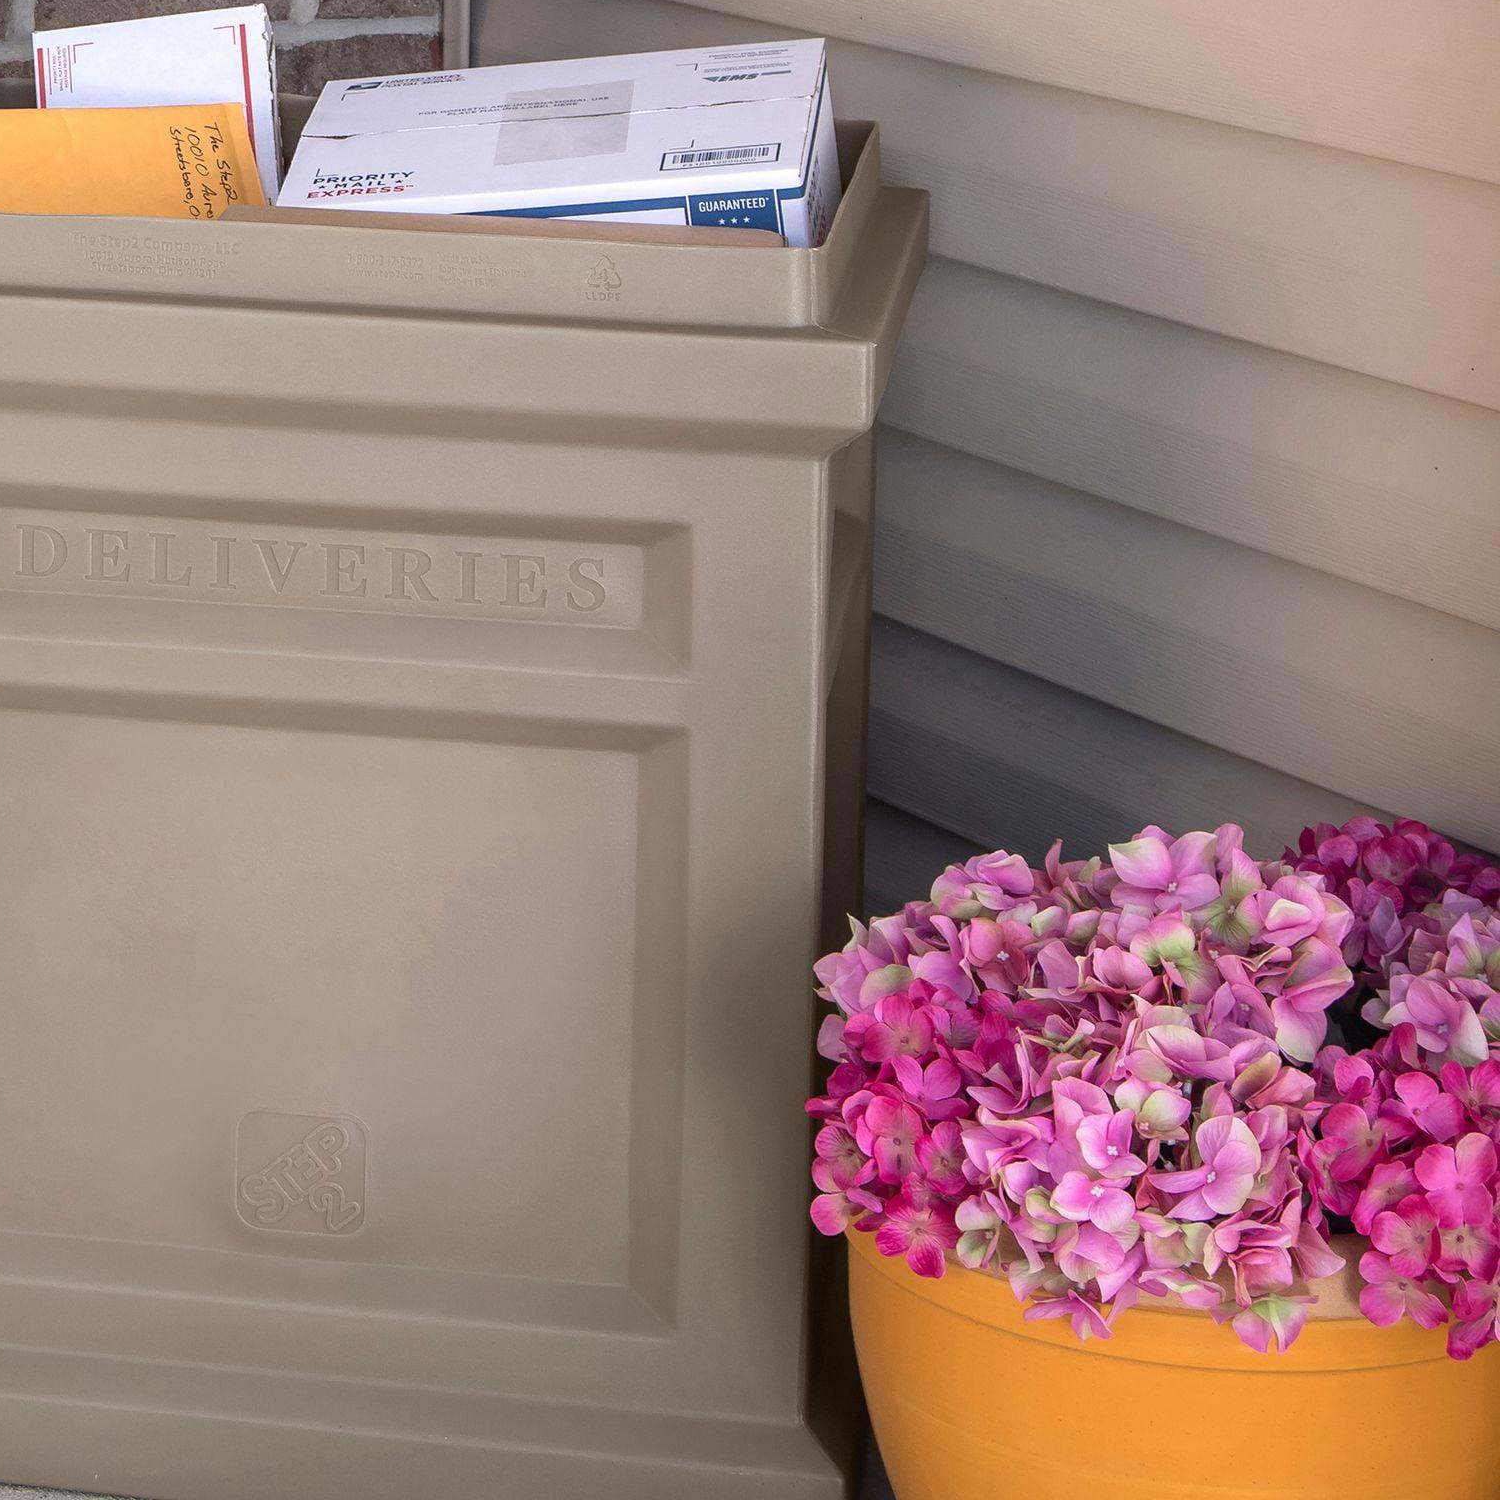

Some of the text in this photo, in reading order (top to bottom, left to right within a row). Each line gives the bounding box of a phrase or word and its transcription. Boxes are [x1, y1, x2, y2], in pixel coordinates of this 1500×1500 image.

[717, 73, 759, 83] EMS
[204, 121, 220, 154] The
[184, 126, 210, 177] 10010
[312, 171, 414, 185] PRIORITY
[334, 180, 386, 189] MAIL
[98, 234, 140, 250] Step2
[584, 291, 621, 301] LLDPE
[12, 522, 608, 613] DELIVERIES
[239, 1122, 350, 1224] STEP
[308, 1181, 362, 1232] 2
